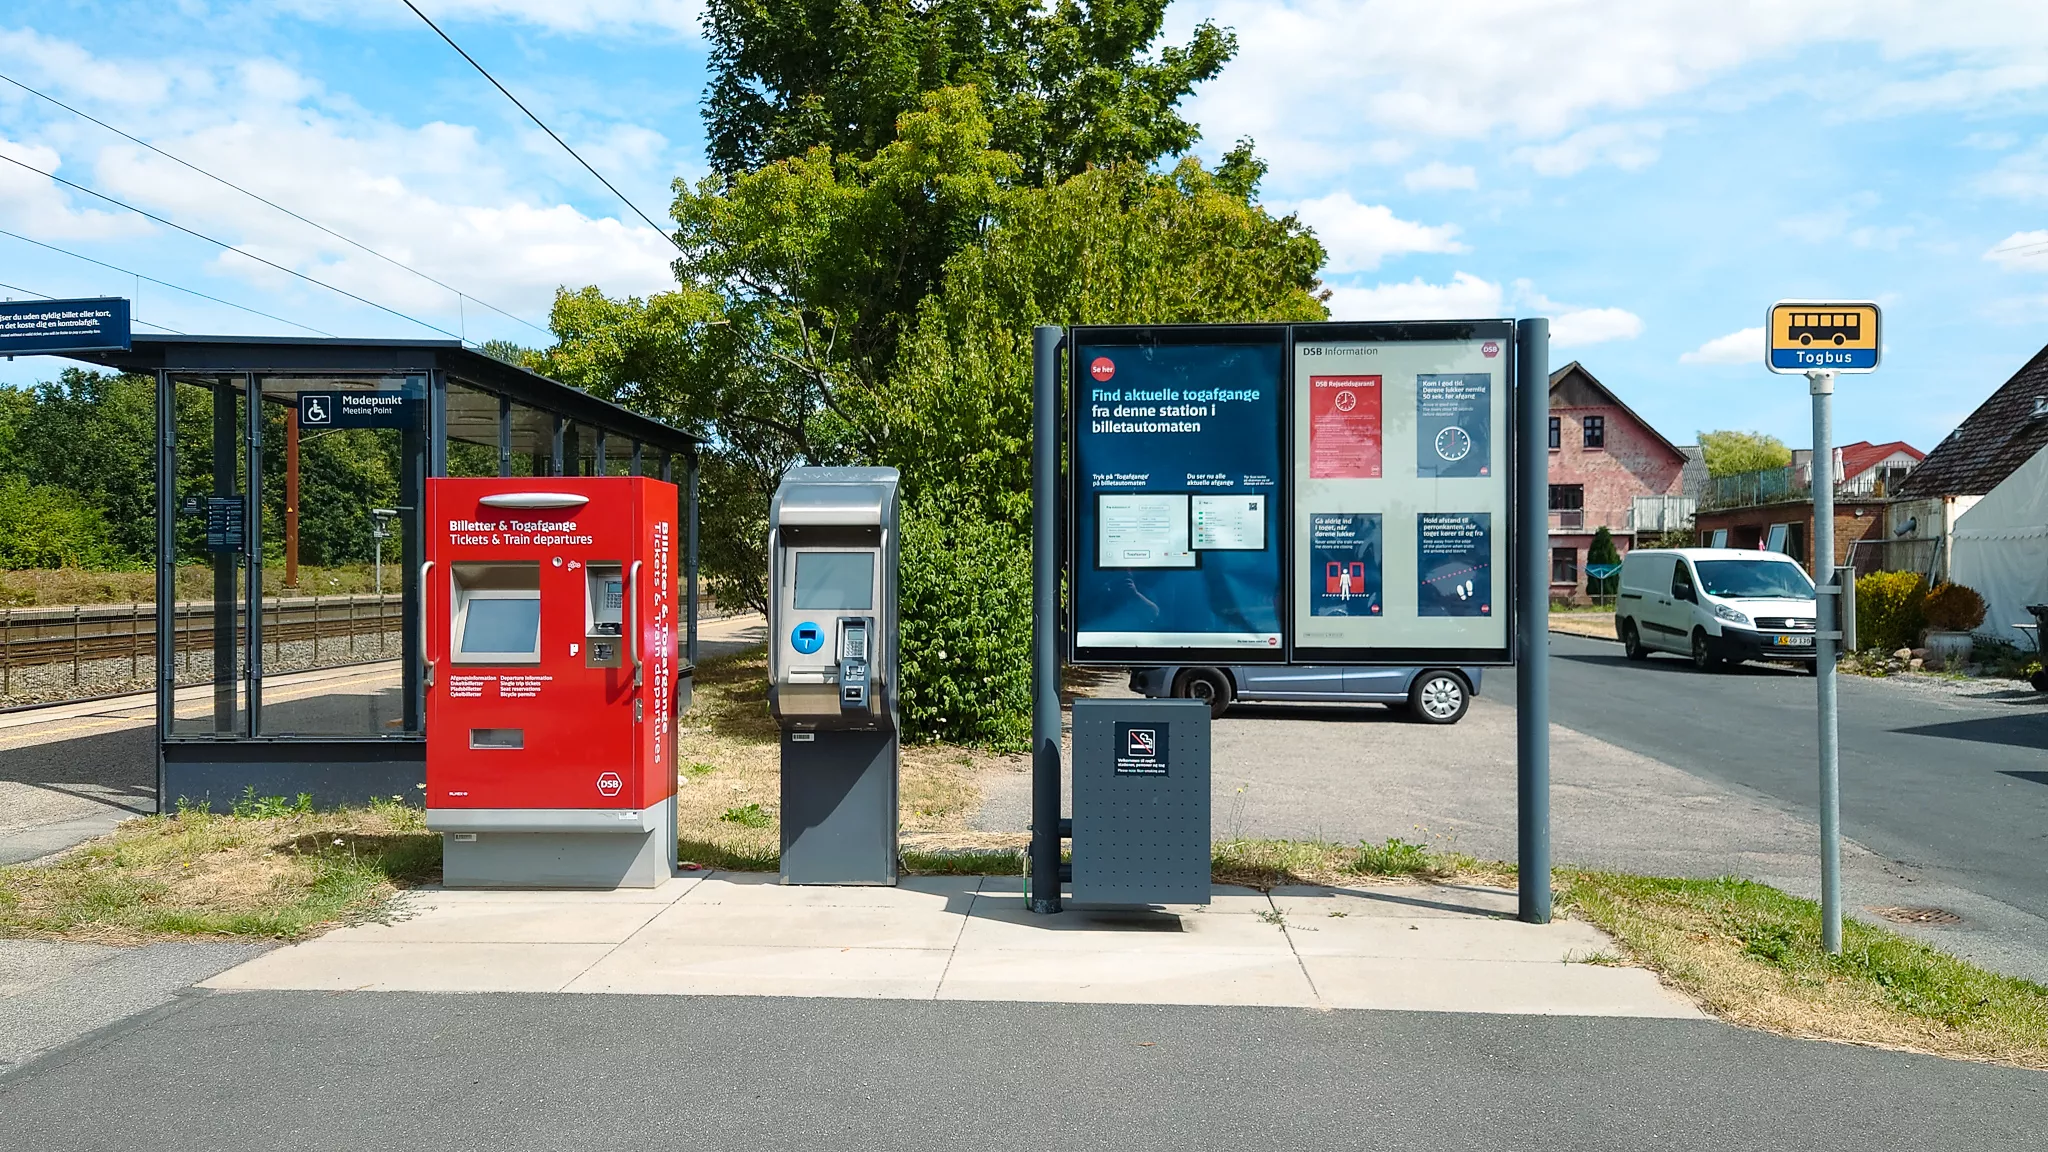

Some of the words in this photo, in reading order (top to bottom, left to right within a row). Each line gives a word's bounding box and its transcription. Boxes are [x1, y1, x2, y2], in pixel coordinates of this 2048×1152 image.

[41, 312, 61, 320] gyldig
[96, 310, 111, 318] kort,
[58, 319, 100, 327] kontrolafgift.
[1304, 347, 1322, 356] DSB
[1325, 346, 1378, 356] Information
[1796, 351, 1852, 365] Togbus
[1329, 380, 1374, 388] Rejsetidsgaranti
[342, 395, 402, 406] Mødepunkt
[1092, 389, 1120, 401] Find
[1124, 389, 1179, 401] aktuelle
[1183, 388, 1260, 402] togafgange
[342, 407, 372, 415] Meeting
[1092, 405, 1110, 417] fra
[1113, 405, 1156, 417] denne
[1160, 404, 1207, 416] station
[1211, 404, 1216, 416] i
[1092, 421, 1200, 433] billetautomaten
[450, 520, 496, 531] Billetter
[499, 521, 508, 531] &
[510, 520, 576, 532] Togafgange
[450, 534, 488, 544] Tickets
[492, 534, 500, 544] &
[503, 534, 530, 544] Train
[533, 533, 592, 546] departures
[654, 592, 661, 606] &
[662, 604, 668, 618] &
[661, 622, 669, 734] Togafgange
[600, 780, 618, 788] DSB
